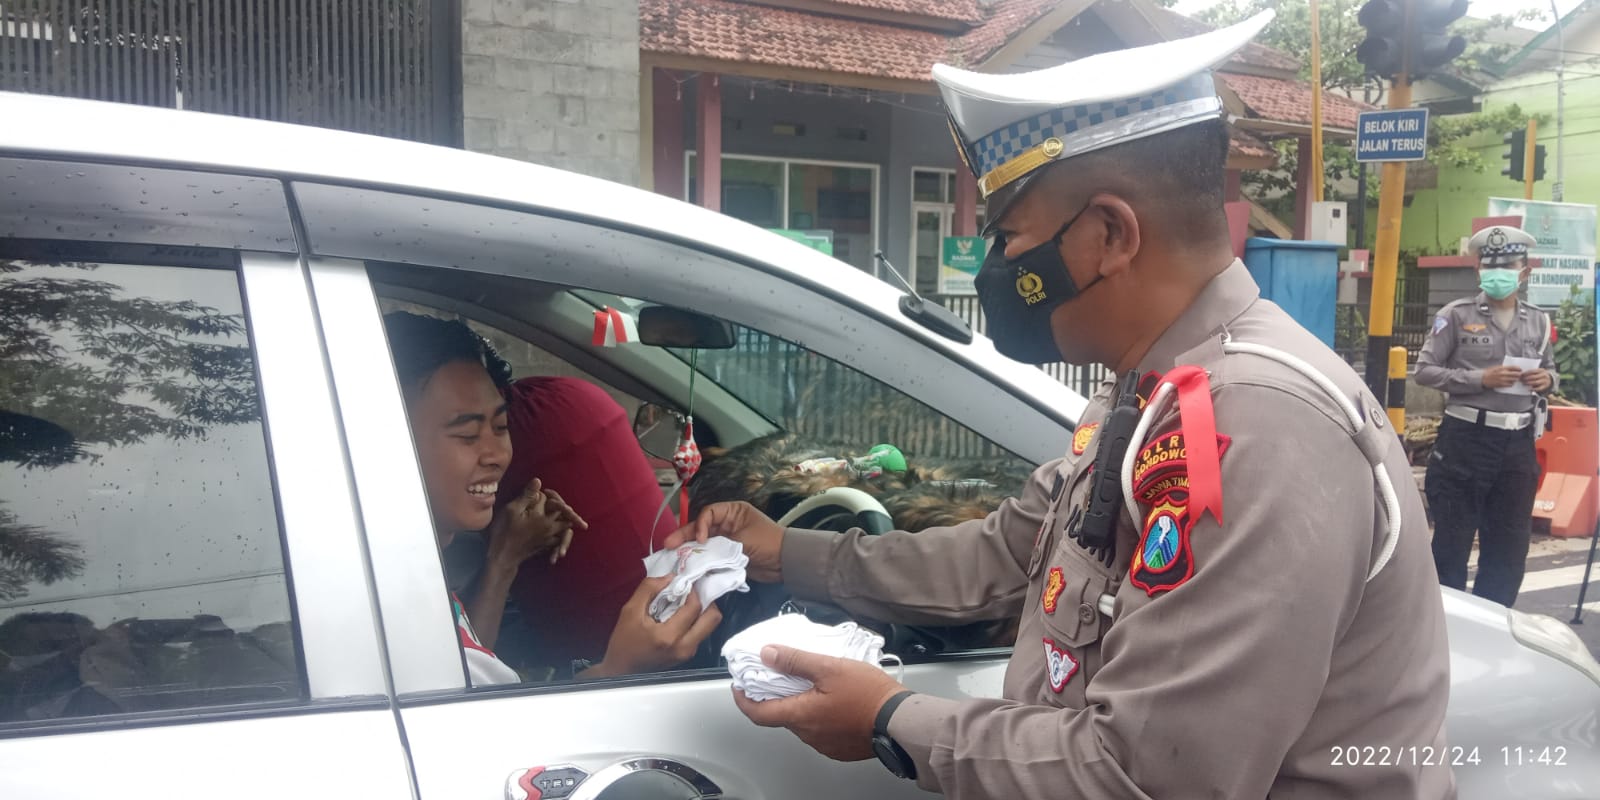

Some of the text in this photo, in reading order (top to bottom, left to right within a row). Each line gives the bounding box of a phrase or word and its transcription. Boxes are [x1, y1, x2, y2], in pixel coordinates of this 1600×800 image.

[1364, 119, 1419, 133] BELOK KIRI
[1359, 138, 1424, 152] JALAN TERUS
[1026, 291, 1046, 305] POLRI
